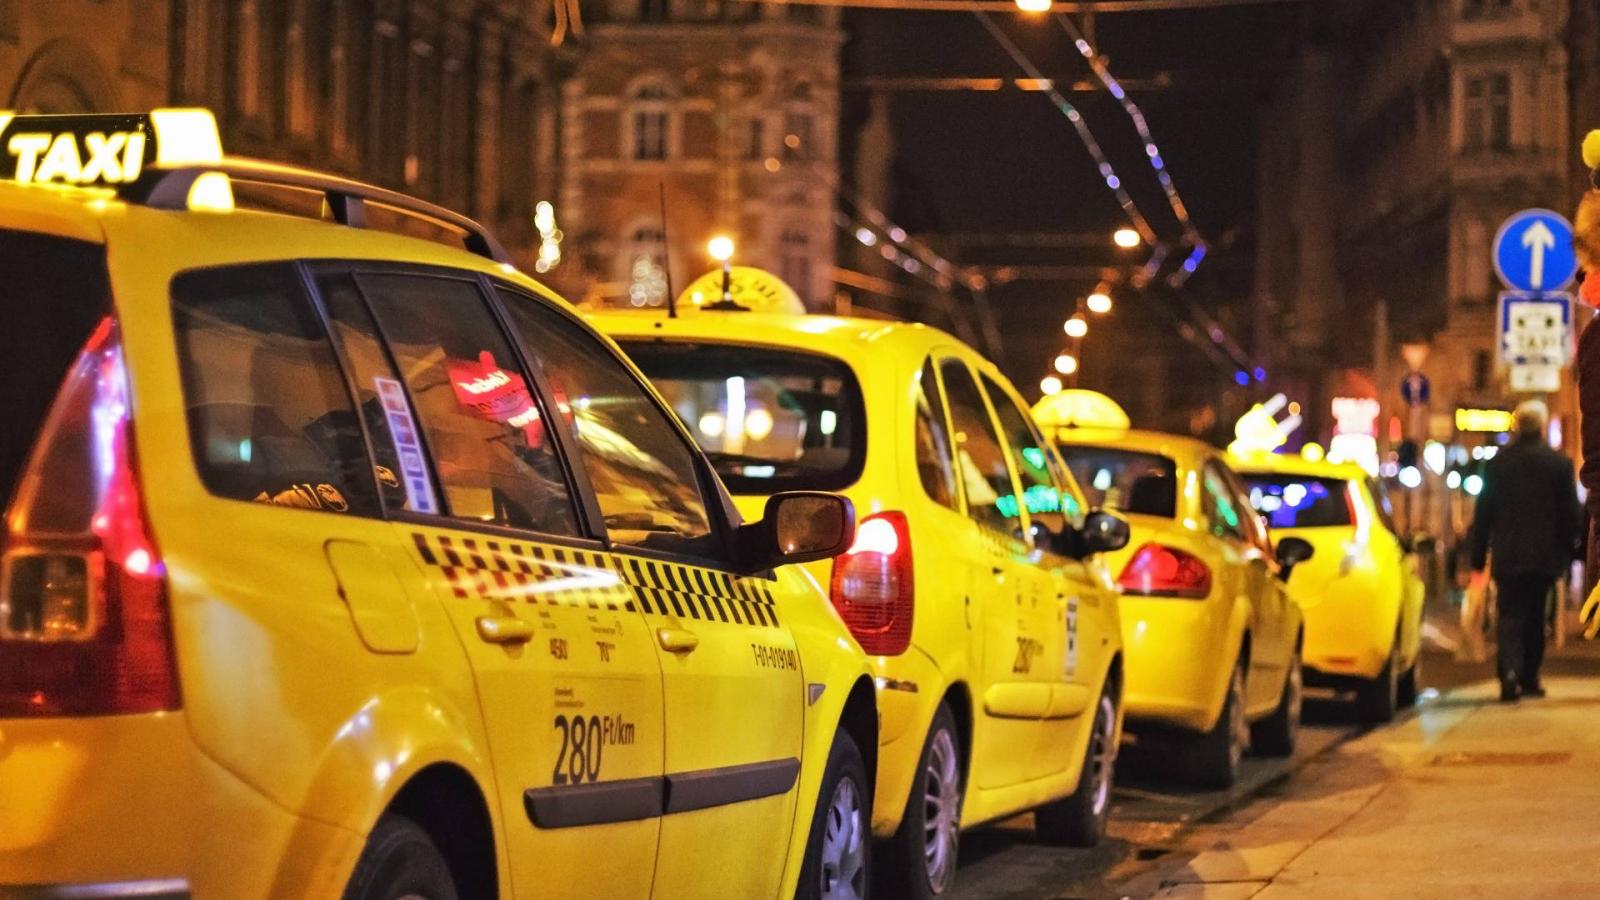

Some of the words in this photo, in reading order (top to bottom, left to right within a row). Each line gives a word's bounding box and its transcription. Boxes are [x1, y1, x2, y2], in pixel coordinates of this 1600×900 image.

[8, 132, 146, 186] TAXI
[751, 643, 797, 671] T-01-019140
[553, 714, 602, 785] 280
[602, 713, 635, 745] Ft/km
